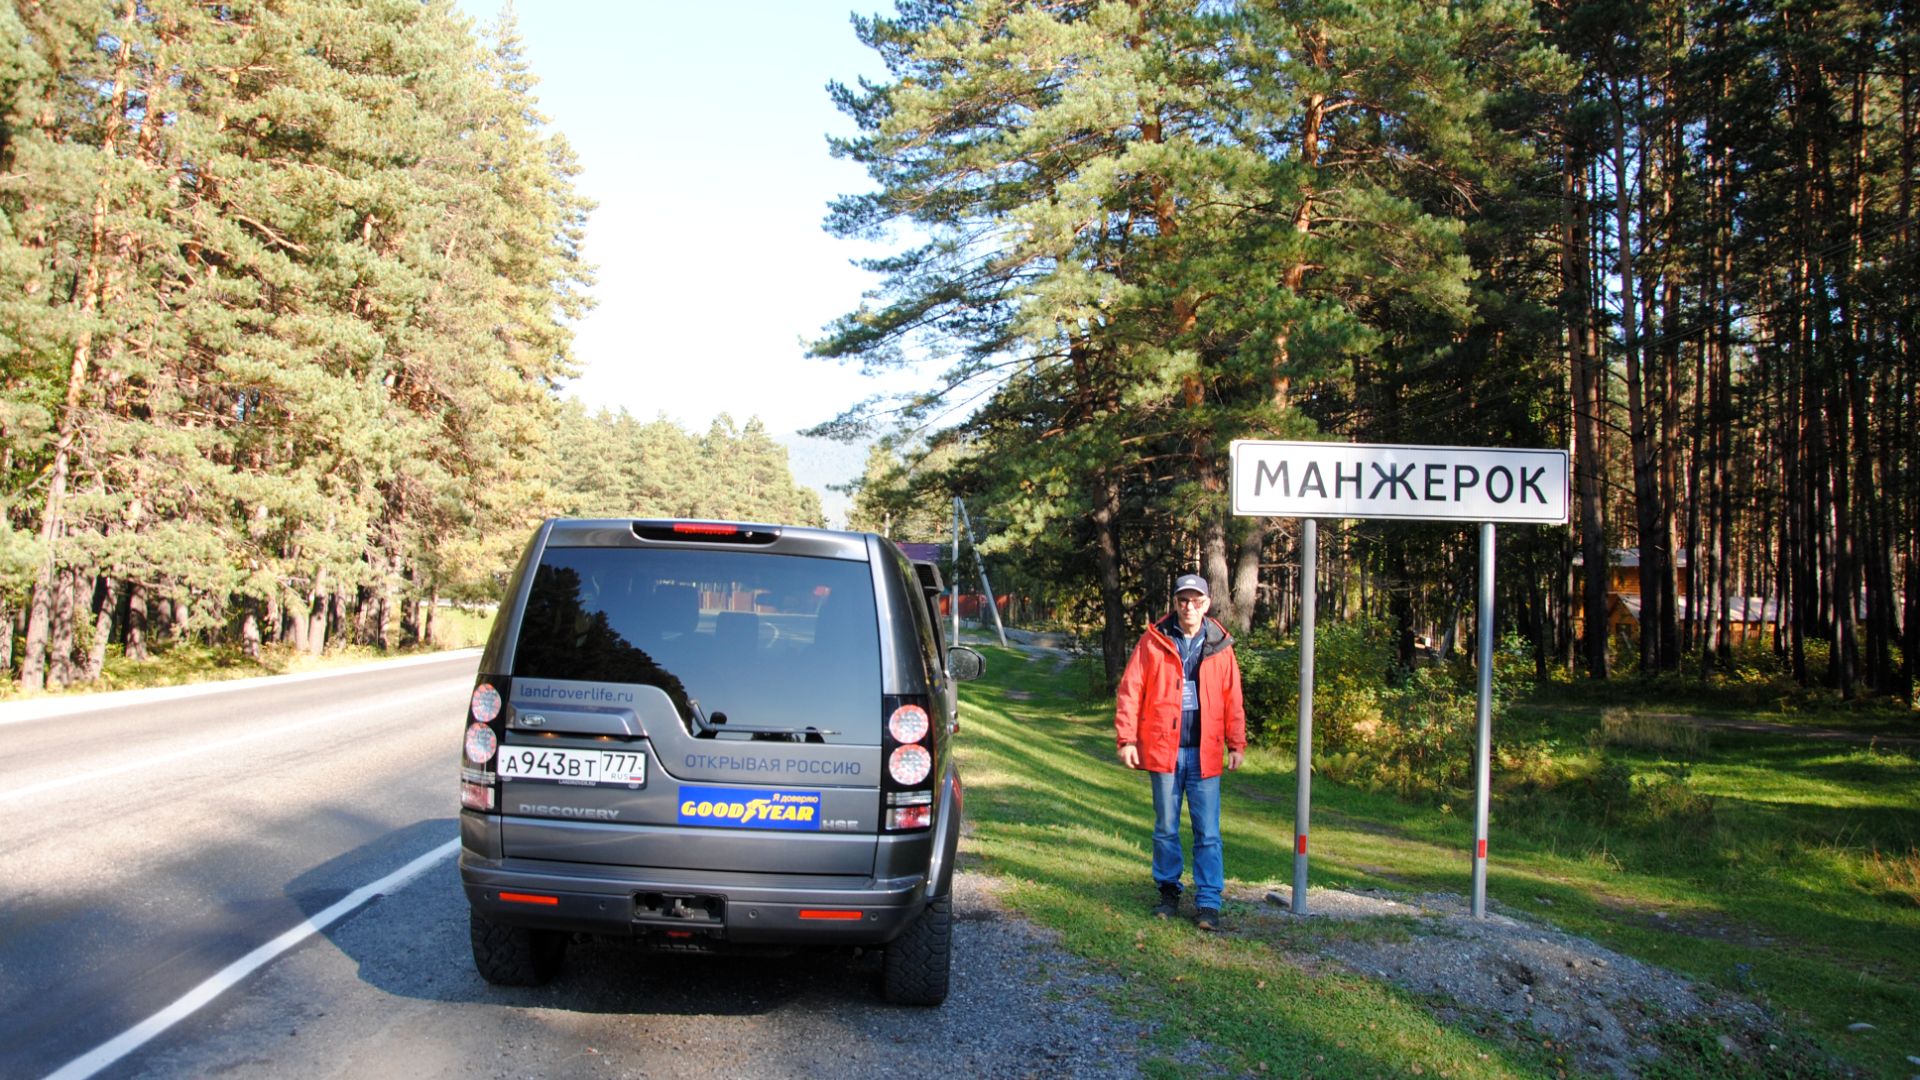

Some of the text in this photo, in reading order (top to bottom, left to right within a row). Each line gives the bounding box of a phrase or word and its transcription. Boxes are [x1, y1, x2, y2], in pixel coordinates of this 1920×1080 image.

[1253, 459, 1549, 505] МАНЖЕРОК
[520, 685, 634, 702] landroverlife.ru
[505, 751, 638, 777] А943ВТ 777
[684, 754, 862, 775] ОТКРЫВАЯ РОССИЮ
[611, 773, 629, 781] RUS
[772, 793, 781, 801] Я
[519, 804, 620, 819] DISCOVERY
[822, 819, 859, 830] HSE
